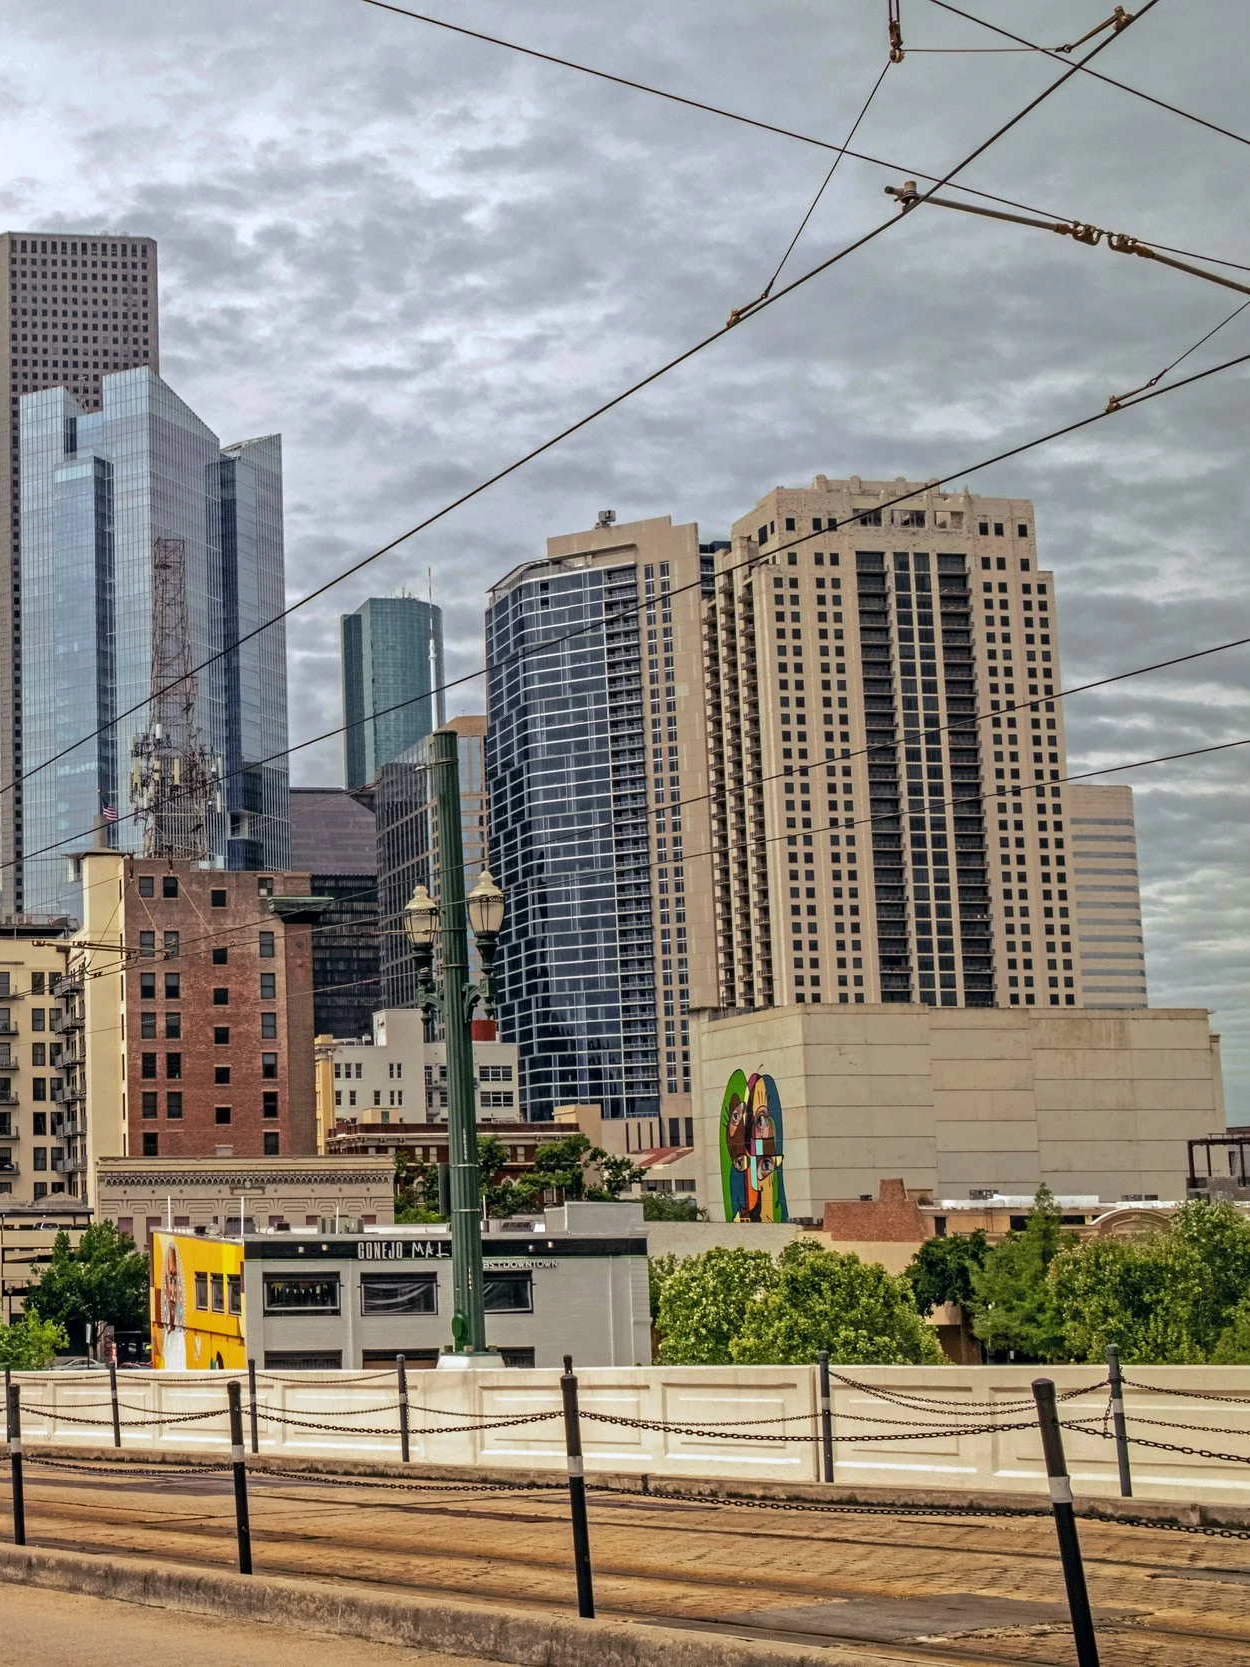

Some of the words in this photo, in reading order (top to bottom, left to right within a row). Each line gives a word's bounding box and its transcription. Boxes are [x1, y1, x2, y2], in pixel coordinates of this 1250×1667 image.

[358, 1241, 403, 1259] CONEJO
[411, 1241, 450, 1259] MAL
[483, 1261, 495, 1269] BS
[503, 1260, 558, 1269] DOWNTOWN
